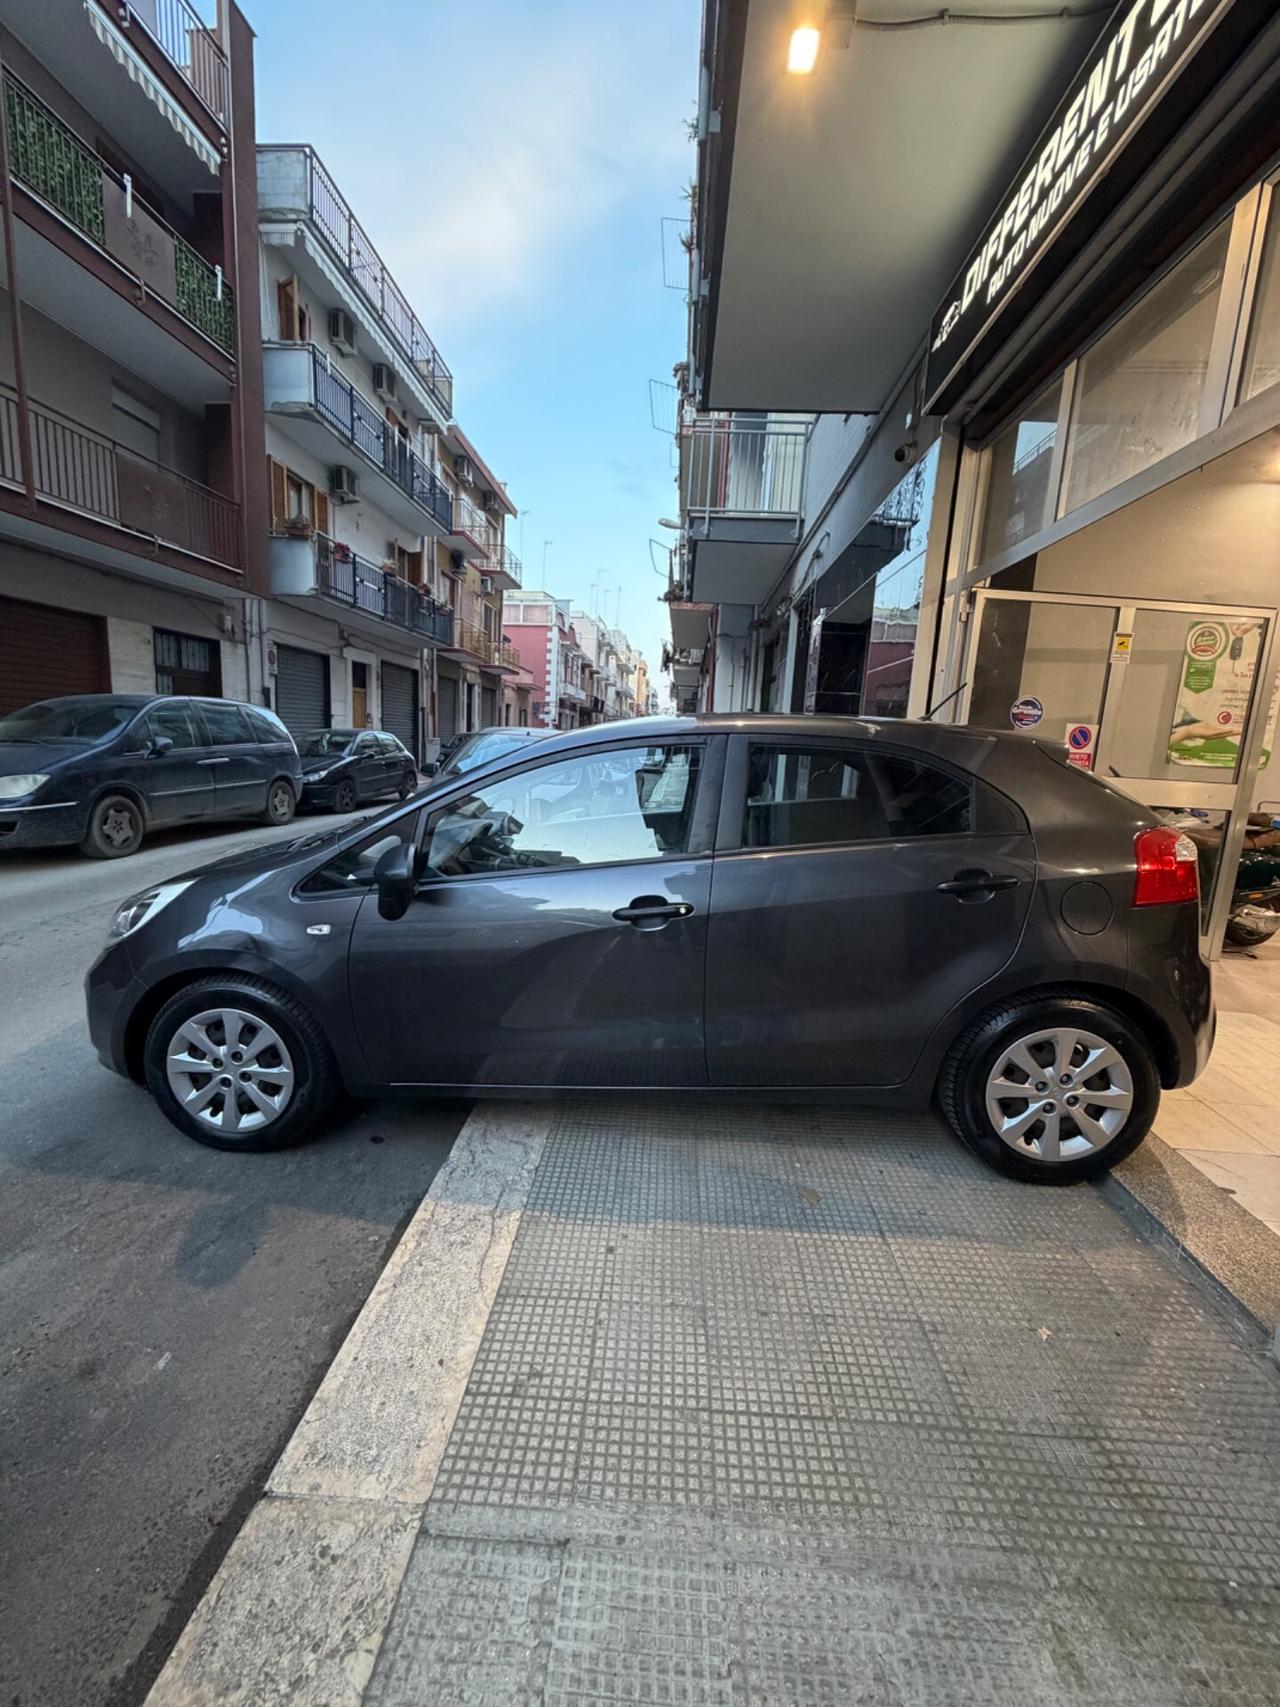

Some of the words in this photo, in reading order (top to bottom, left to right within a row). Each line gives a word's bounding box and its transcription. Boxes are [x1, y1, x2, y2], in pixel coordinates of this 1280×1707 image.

[960, 0, 1146, 315] DIFFERENT
[986, 229, 1027, 304] AUTO
[1026, 130, 1095, 249] NUOVE
[1093, 101, 1114, 153] E
